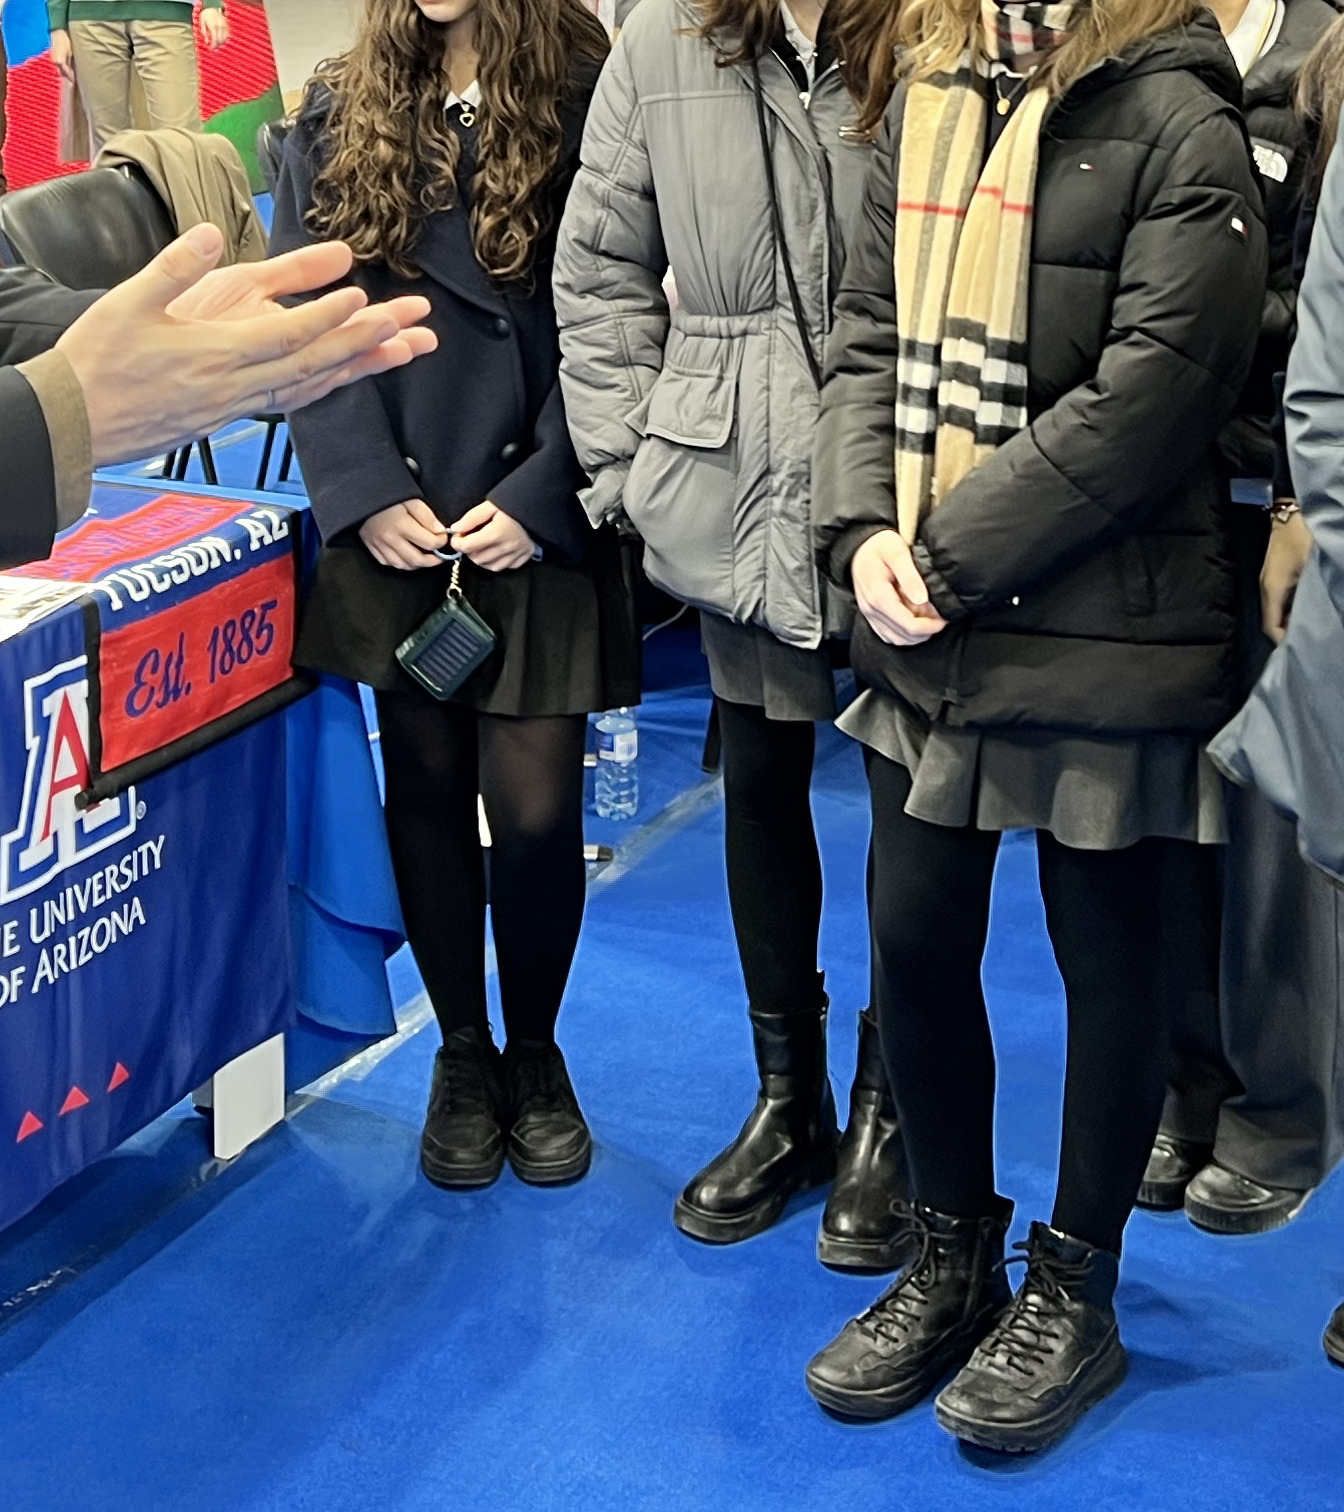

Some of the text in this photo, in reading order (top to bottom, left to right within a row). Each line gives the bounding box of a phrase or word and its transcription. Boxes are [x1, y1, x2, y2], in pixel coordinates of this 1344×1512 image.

[234, 509, 290, 552] AZ
[124, 599, 279, 718] Est. 1885
[29, 834, 166, 945] UNIVERSITY
[31, 896, 147, 994] ARIZONA
